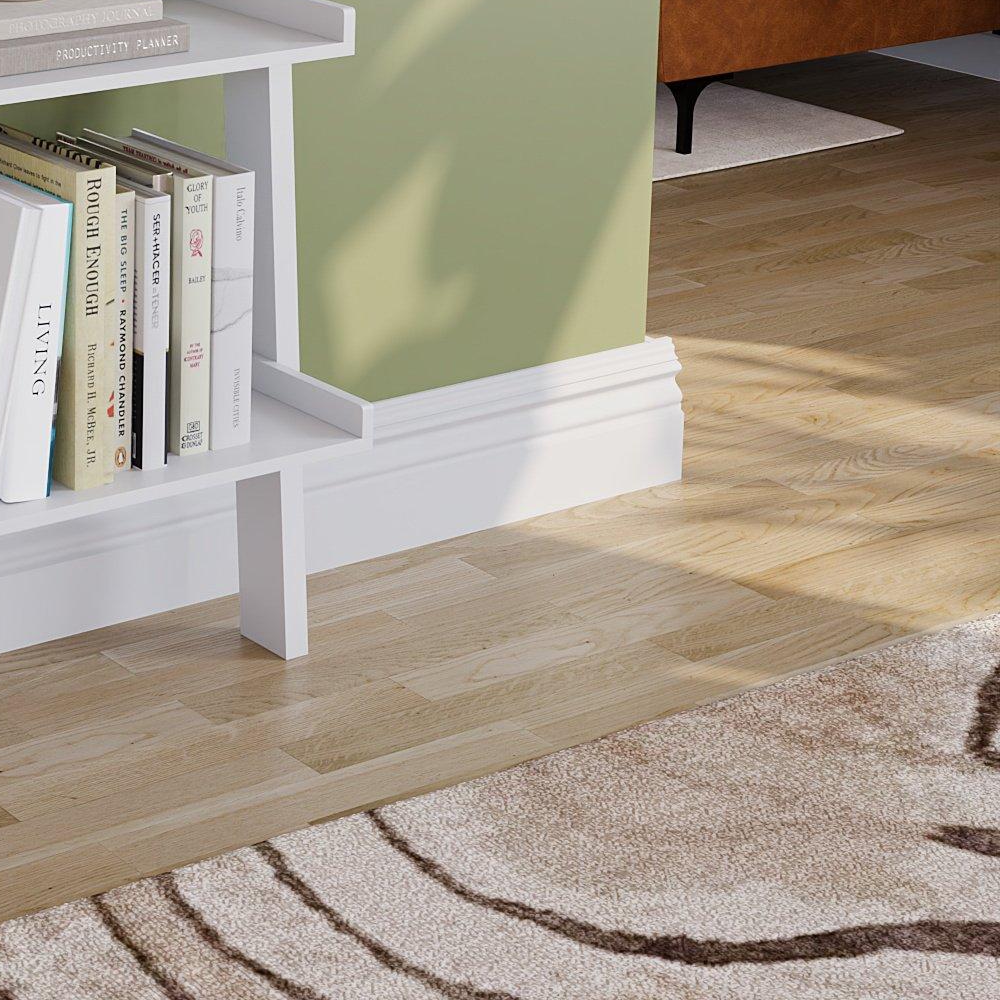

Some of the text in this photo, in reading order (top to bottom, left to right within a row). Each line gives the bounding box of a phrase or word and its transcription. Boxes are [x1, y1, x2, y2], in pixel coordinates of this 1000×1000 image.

[56, 34, 179, 61] PRODUCTIVITY PLANNER
[187, 181, 209, 193] GLORY
[193, 193, 203, 203] OF
[185, 203, 209, 214] YOUTH
[235, 187, 246, 242] Italo Calvino
[85, 177, 102, 317] ROUGH ENOUGH
[188, 275, 206, 285] BAILEY
[118, 208, 128, 437] THE BIG SLEEP RAYMOND CHANDLER
[31, 303, 52, 396] LIVING
[87, 391, 97, 403] H.
[86, 448, 96, 468] JR.
